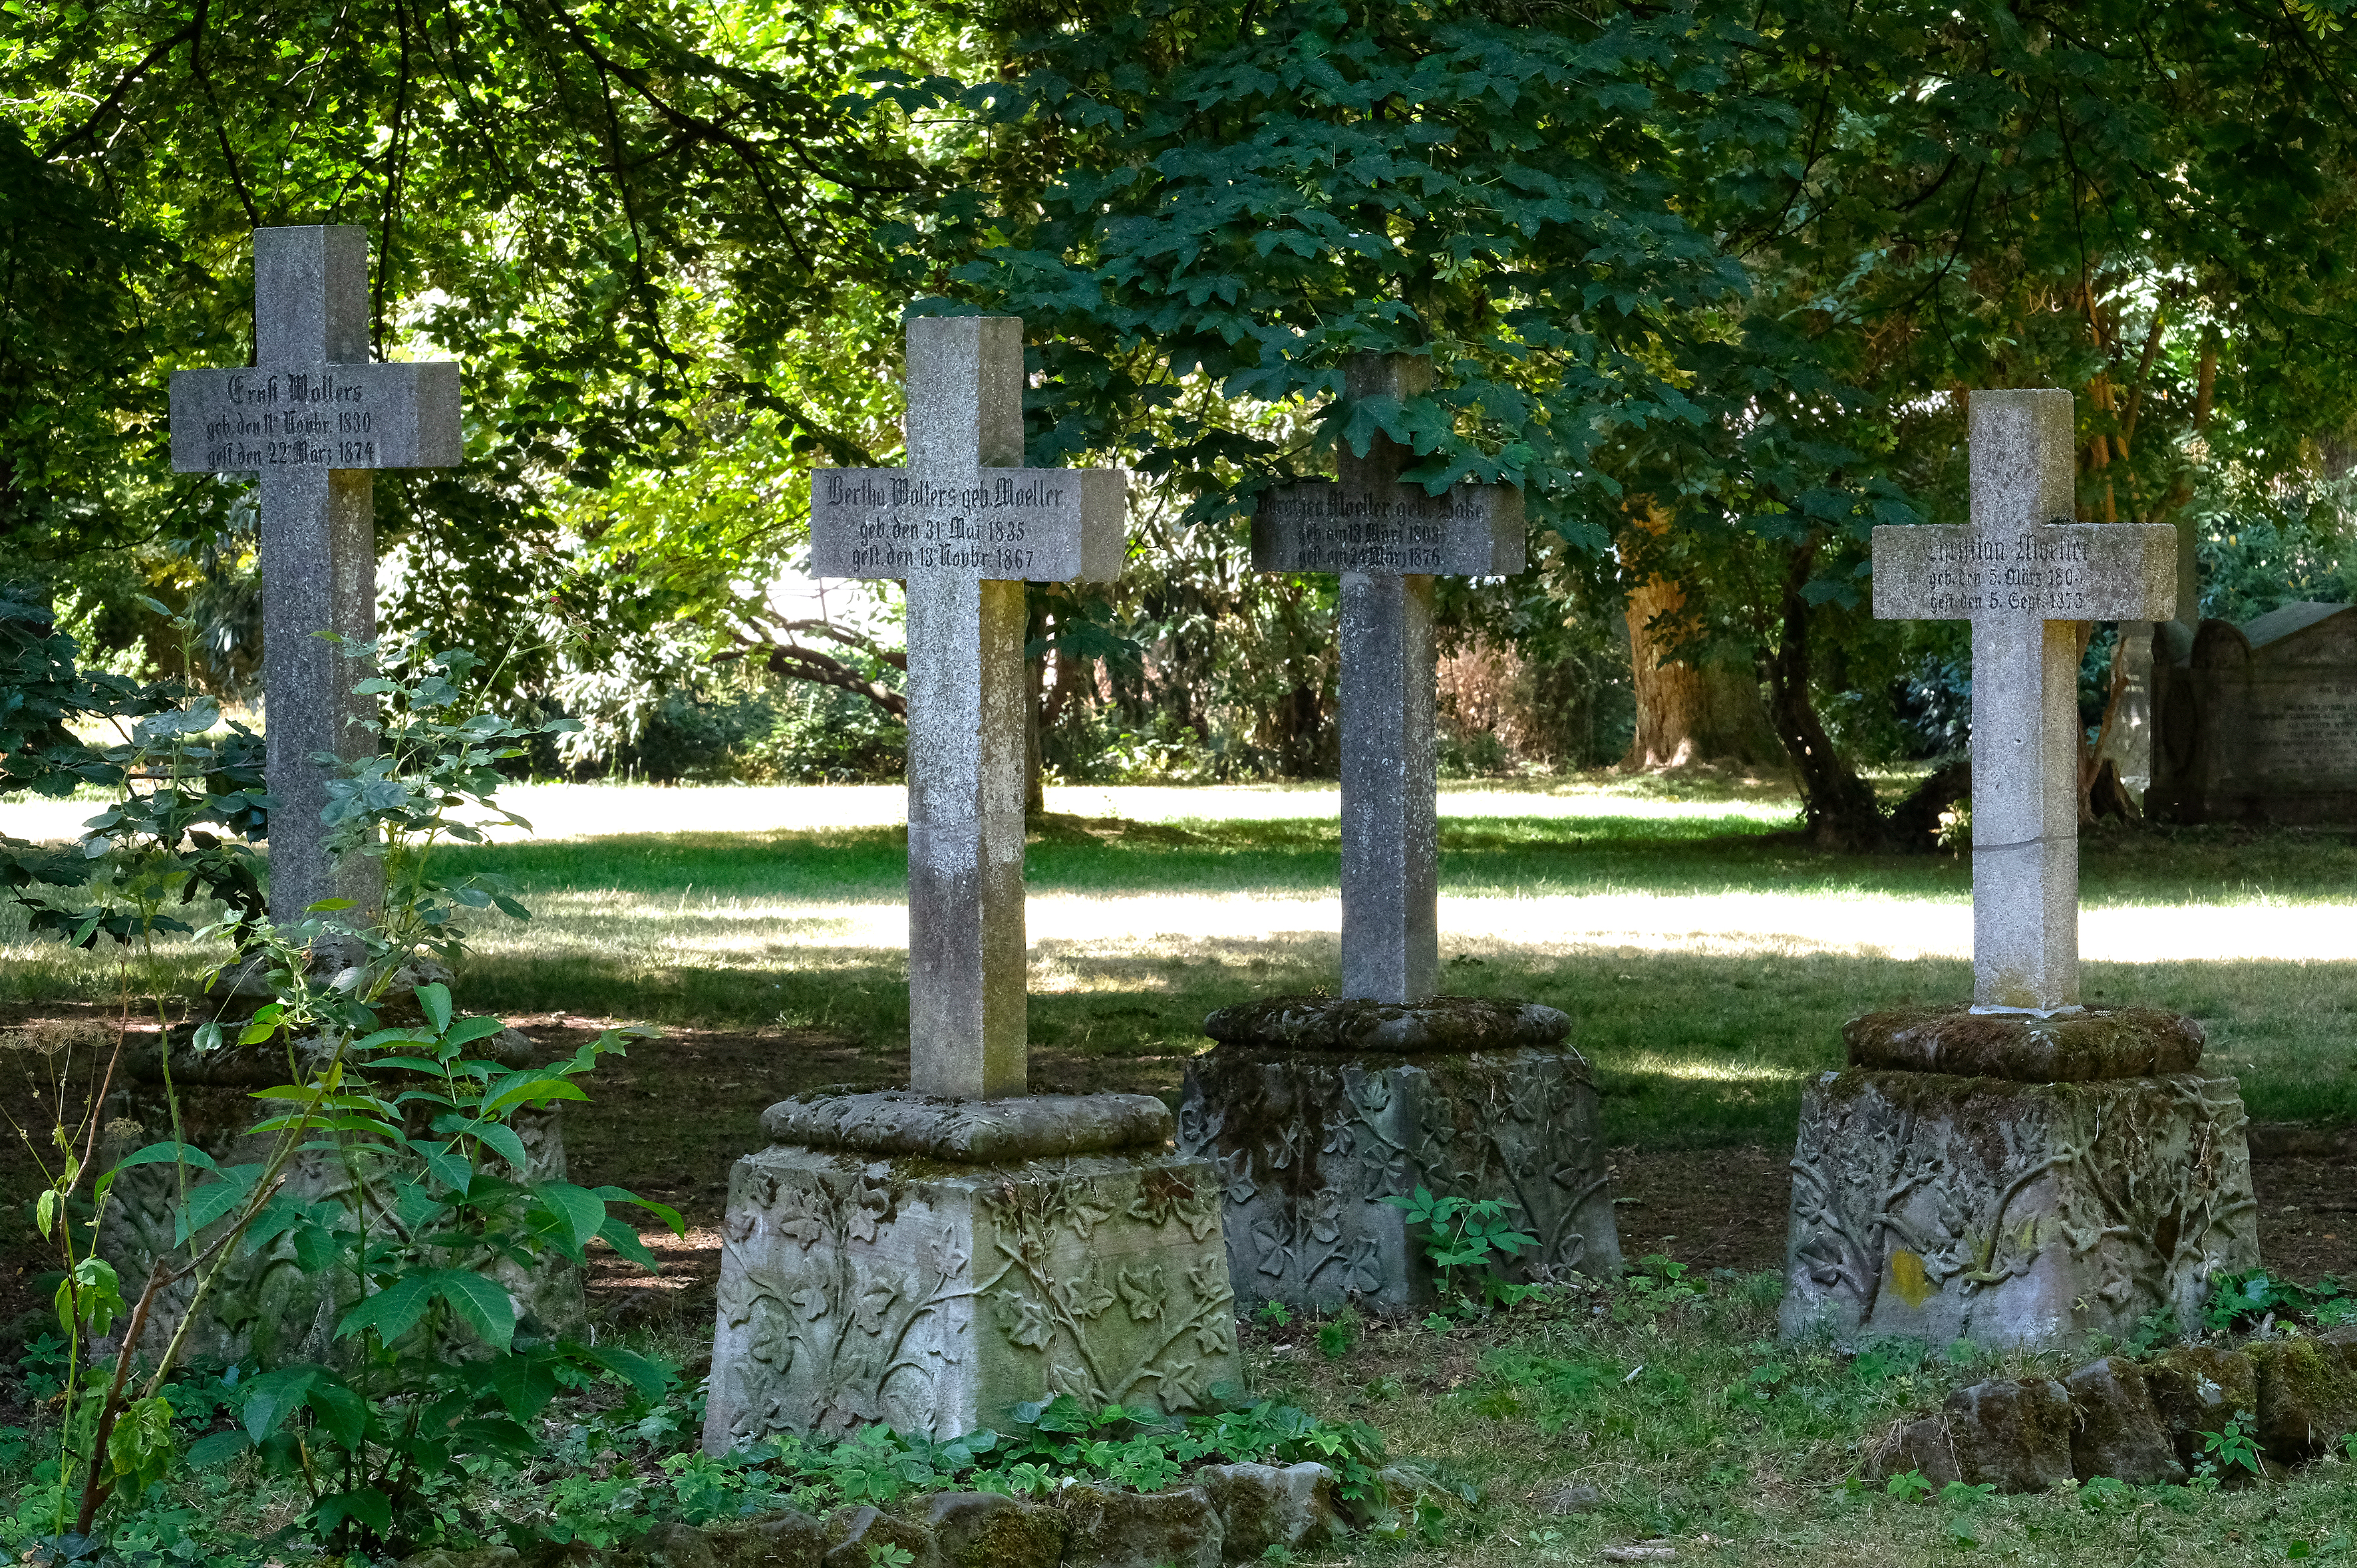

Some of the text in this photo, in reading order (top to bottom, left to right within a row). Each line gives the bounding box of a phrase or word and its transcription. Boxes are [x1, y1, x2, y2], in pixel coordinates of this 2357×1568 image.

[237, 412, 261, 436] den
[338, 411, 371, 434] 1830
[237, 442, 262, 466] den
[339, 441, 374, 464] 1874
[826, 475, 885, 510] Bertha
[889, 477, 956, 508] Wolters
[994, 477, 1064, 509] Moeller
[859, 516, 889, 547] geb.
[892, 516, 919, 540] den
[949, 516, 981, 540] Mai
[989, 520, 1025, 542] 1835
[887, 542, 913, 567] den
[997, 548, 1034, 571] 1867
[1408, 546, 1441, 567] 1876
[1989, 568, 2002, 585] 5.
[1989, 591, 2002, 609] 5.
